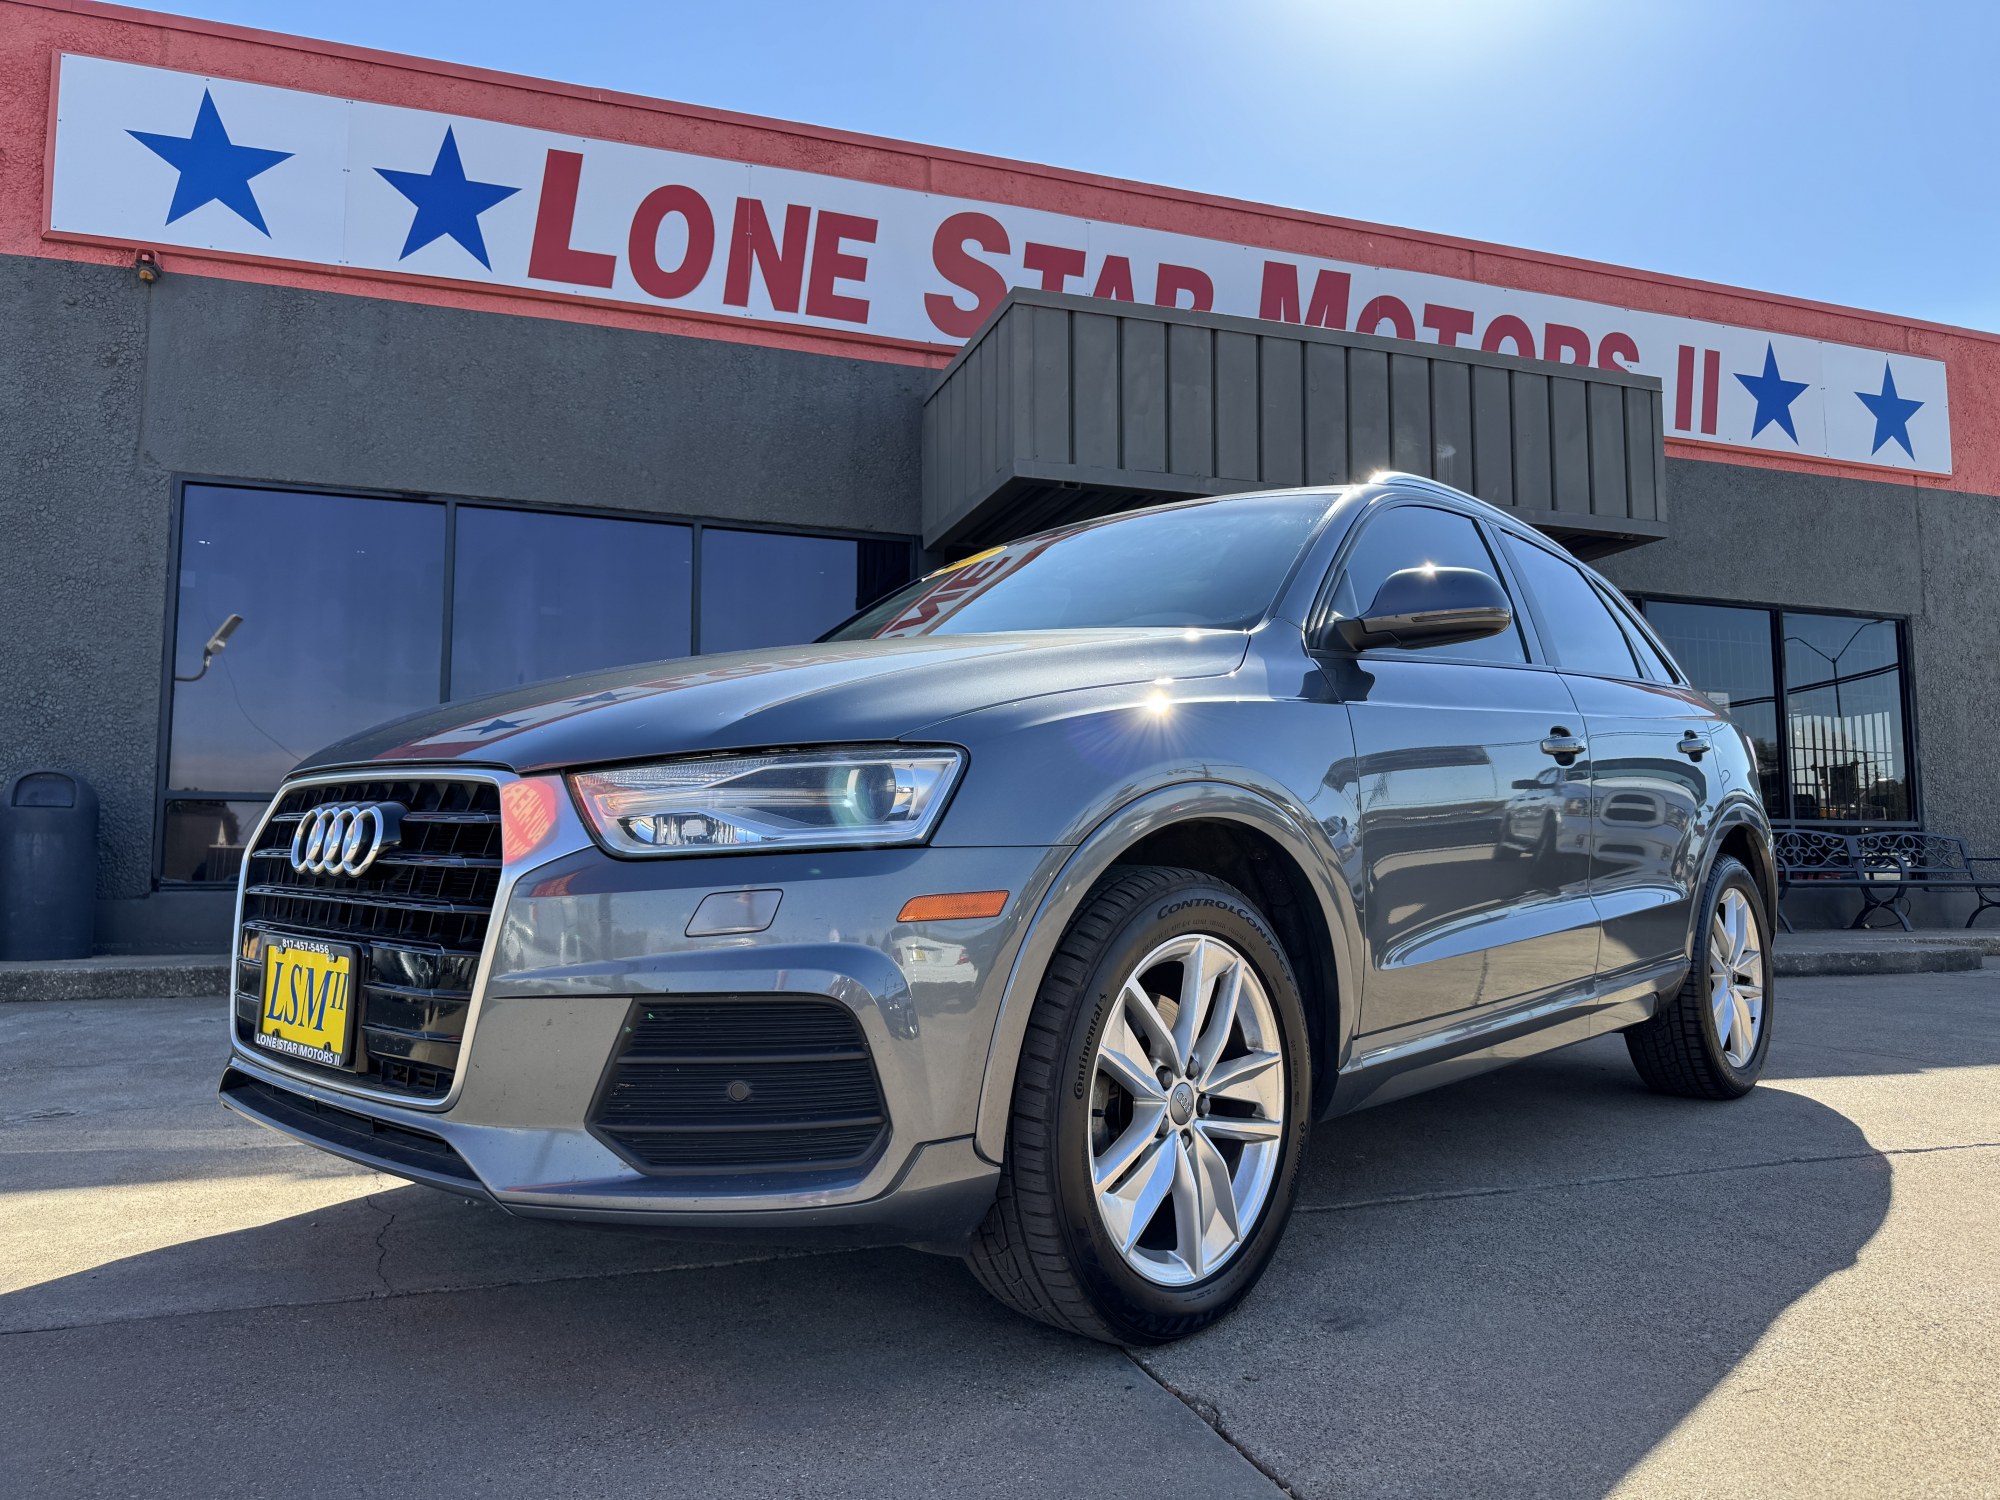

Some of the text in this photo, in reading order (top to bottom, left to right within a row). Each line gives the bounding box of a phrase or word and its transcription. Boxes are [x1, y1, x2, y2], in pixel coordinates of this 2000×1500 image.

[528, 149, 878, 324] LONE
[1675, 344, 1720, 435] II
[282, 938, 330, 954] 817-457-5456
[256, 1033, 277, 1047] LONE
[278, 1039, 298, 1054] STAR
[299, 1045, 334, 1064] MOTORS
[1073, 1002, 1103, 1100] Continental
